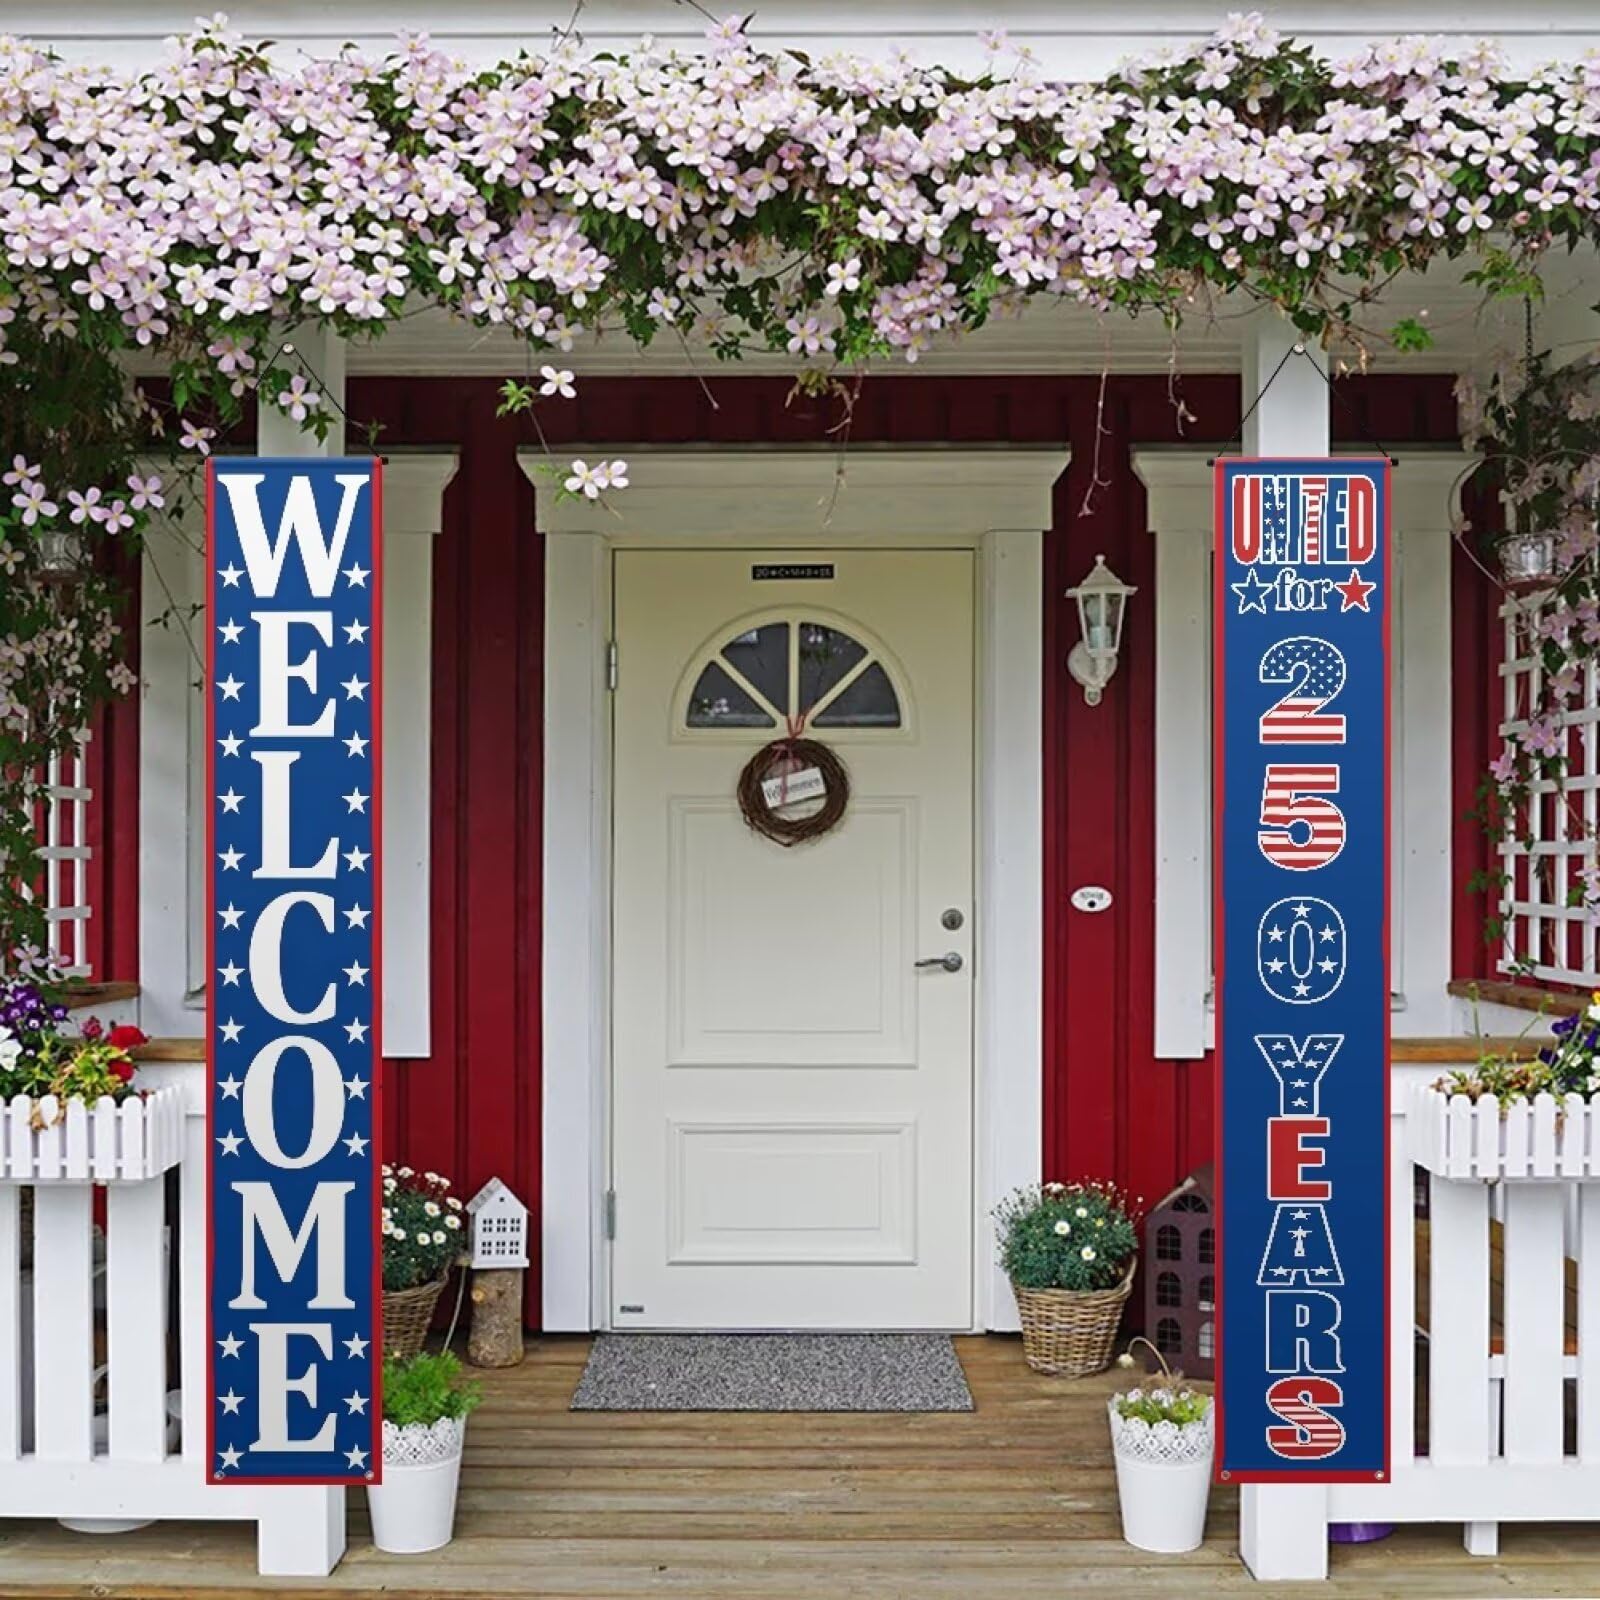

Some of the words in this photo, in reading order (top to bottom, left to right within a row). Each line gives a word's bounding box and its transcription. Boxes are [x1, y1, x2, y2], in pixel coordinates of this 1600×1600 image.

[1231, 474, 1377, 565] UNITED
[1274, 567, 1334, 611] for
[217, 474, 370, 1452] WELCOME
[1257, 635, 1347, 1005] 250
[1254, 1034, 1346, 1460] YEARS
